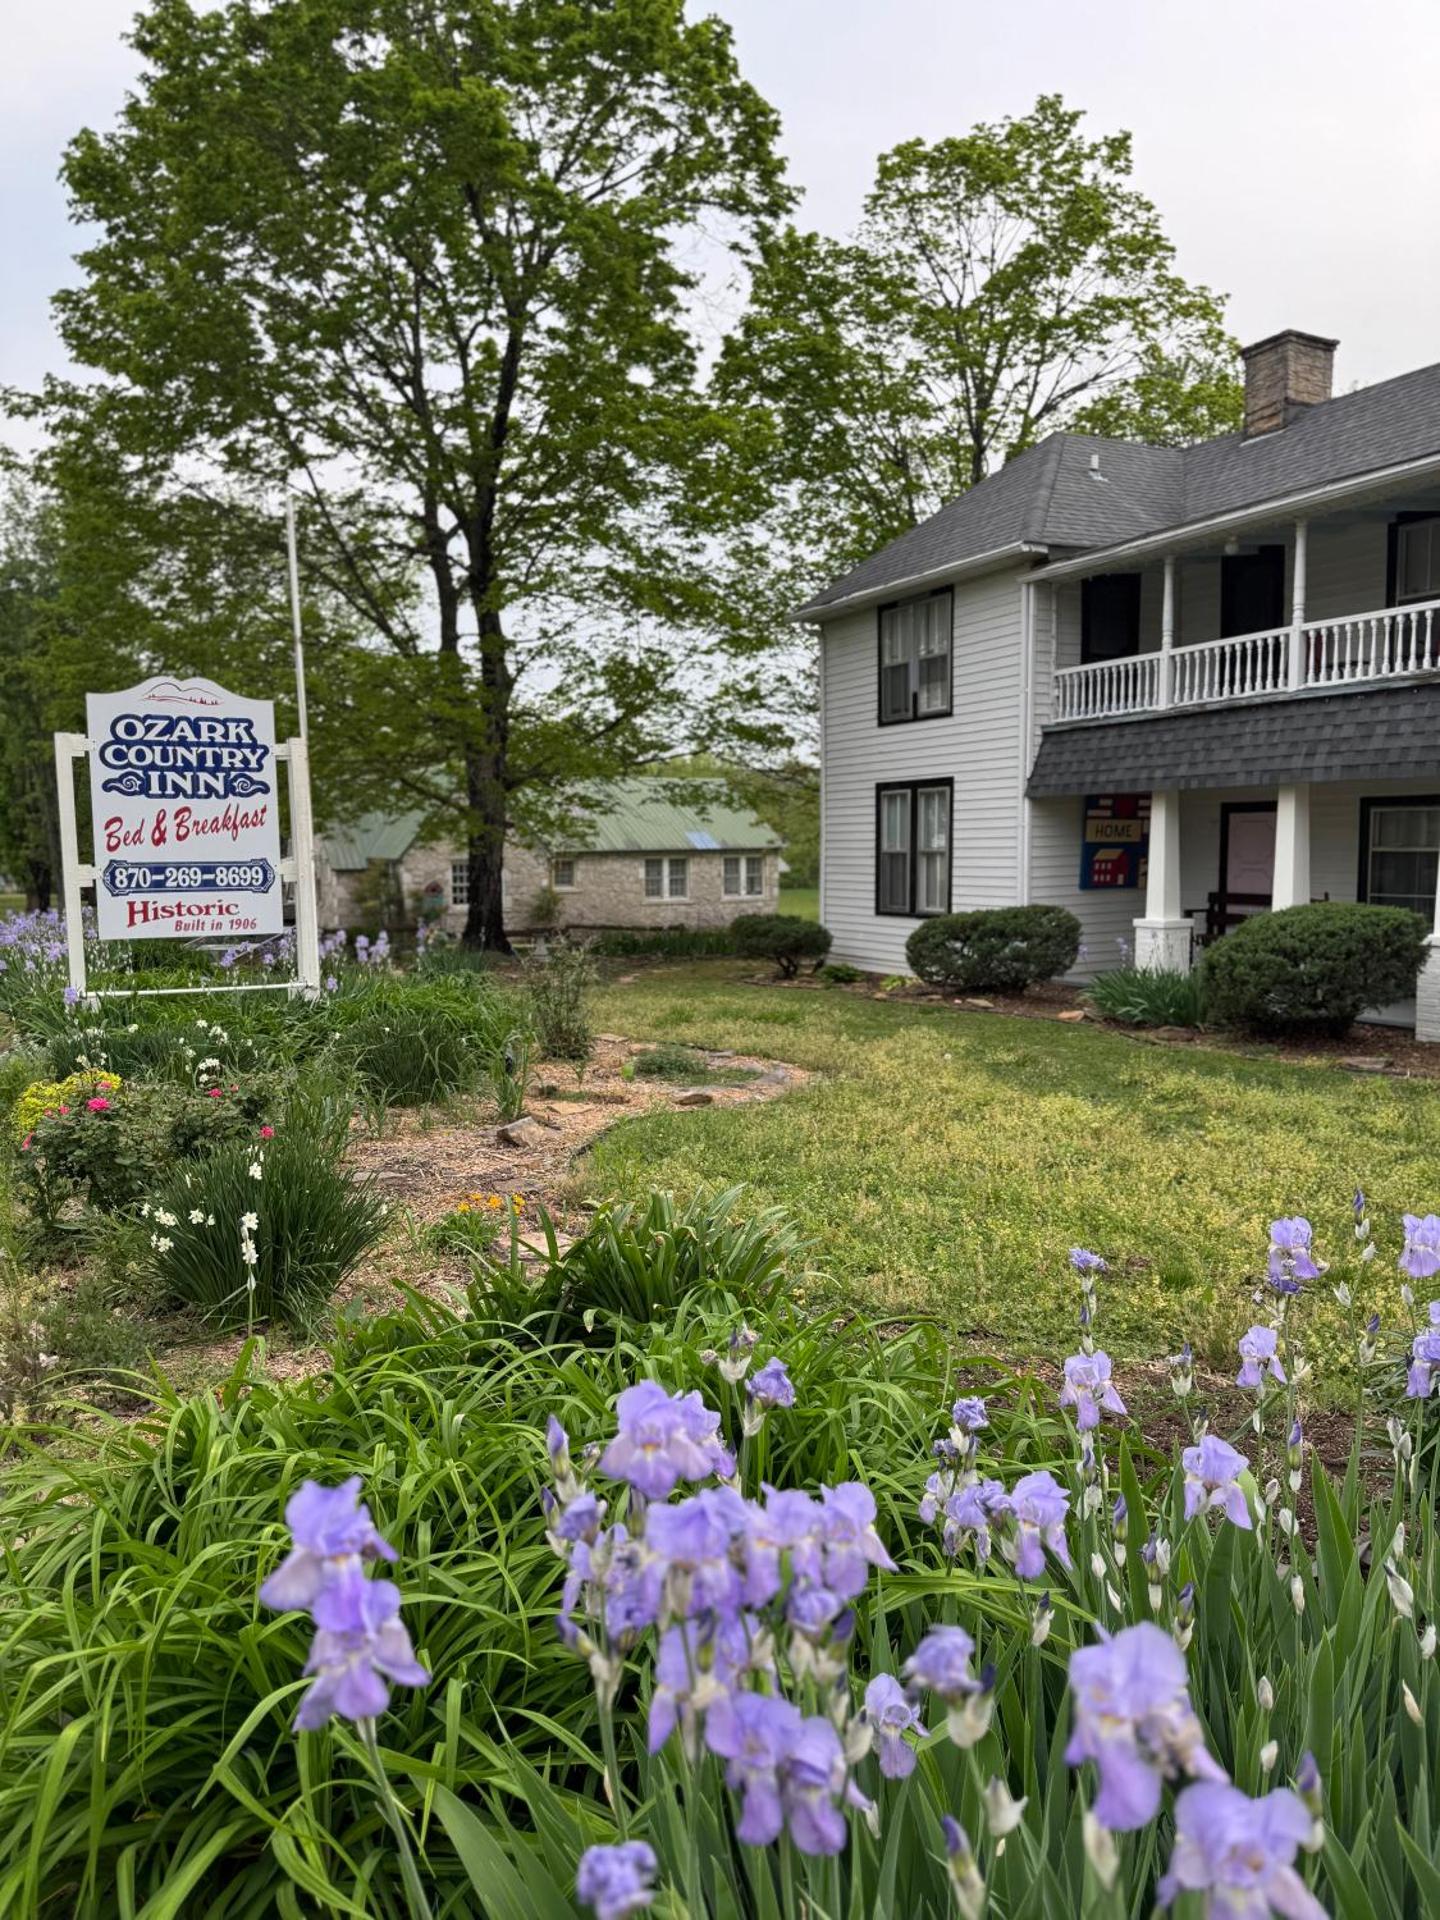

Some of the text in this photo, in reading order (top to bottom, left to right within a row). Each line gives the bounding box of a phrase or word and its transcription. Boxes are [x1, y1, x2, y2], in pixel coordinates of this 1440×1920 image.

[115, 718, 255, 743] OZARK
[104, 744, 265, 768] COUNTRY
[148, 771, 226, 795] INN
[104, 801, 267, 852] Bed & Breakfast
[1095, 823, 1133, 838] HOME
[114, 866, 263, 888] 870-269-8699
[127, 899, 240, 928] Historic
[174, 918, 257, 932] Built in 1906
